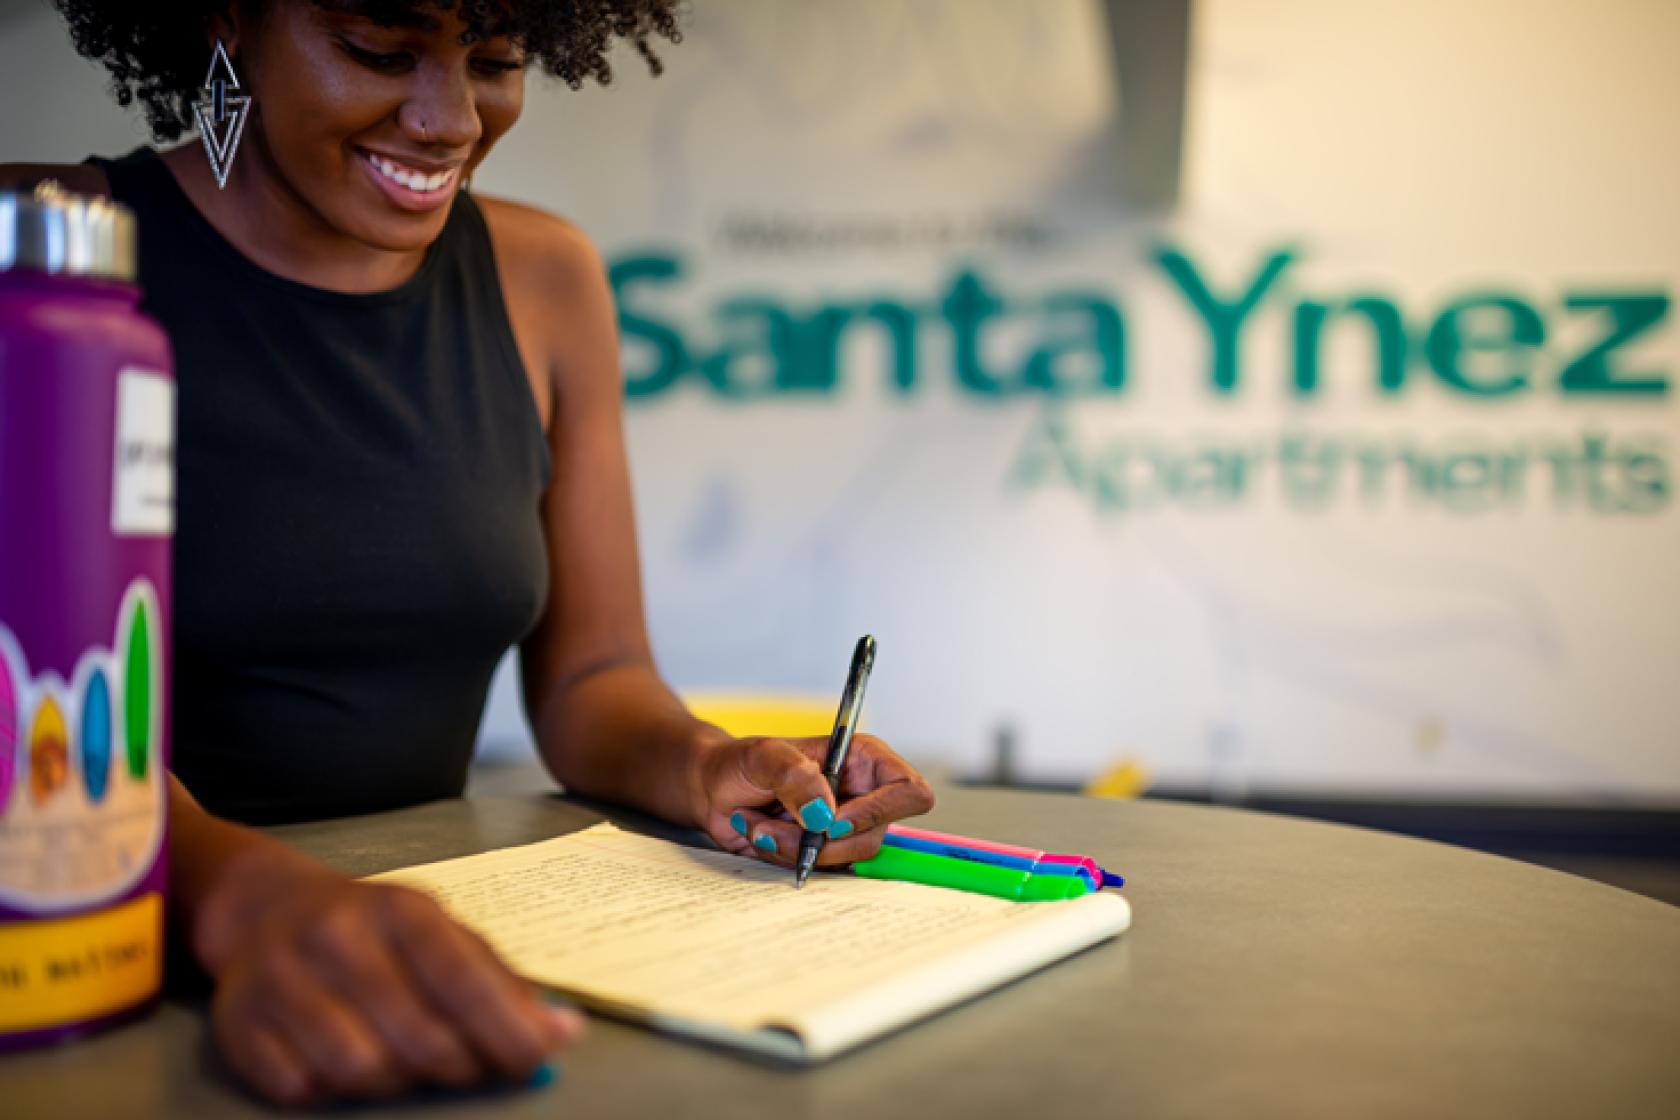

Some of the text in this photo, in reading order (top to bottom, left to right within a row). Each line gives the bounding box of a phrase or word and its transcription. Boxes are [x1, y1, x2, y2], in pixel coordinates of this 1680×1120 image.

[606, 246, 1671, 398] Santa Ynez
[1002, 408, 1671, 517] Apartments
